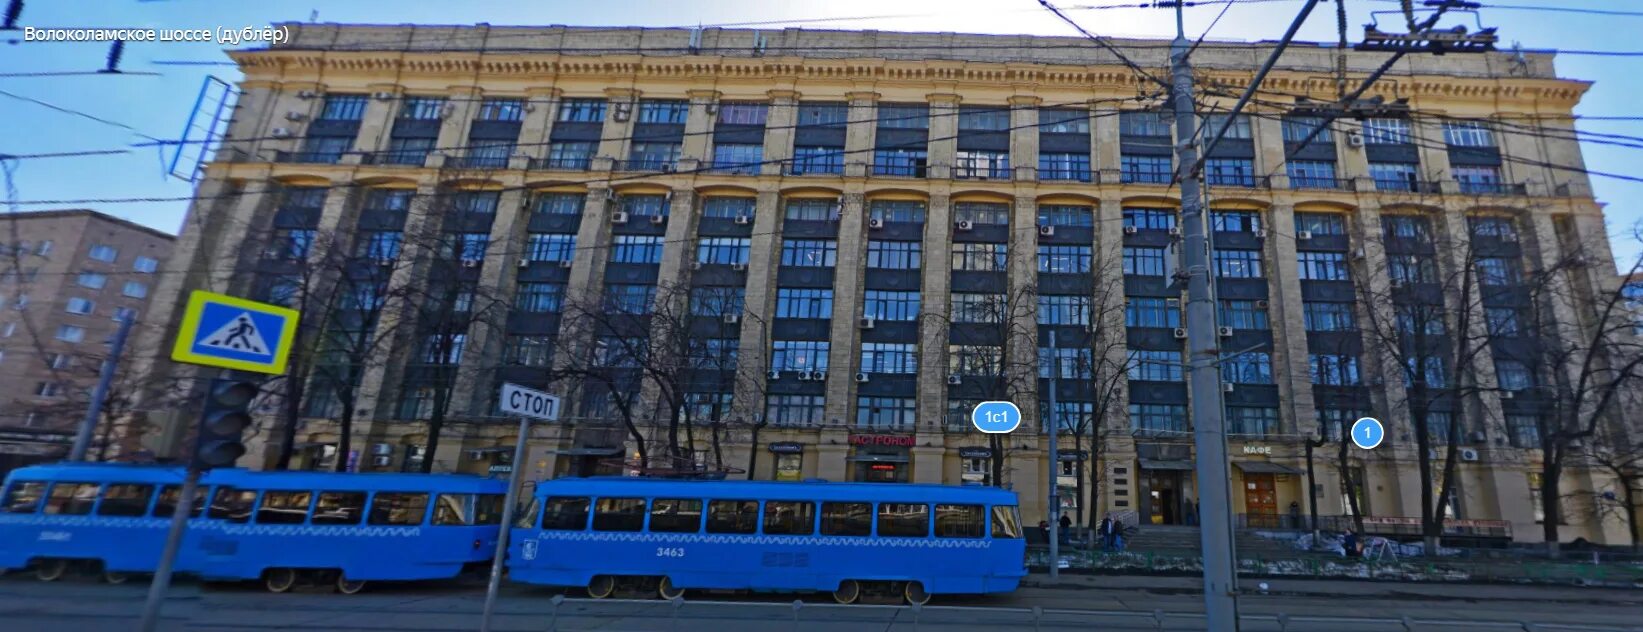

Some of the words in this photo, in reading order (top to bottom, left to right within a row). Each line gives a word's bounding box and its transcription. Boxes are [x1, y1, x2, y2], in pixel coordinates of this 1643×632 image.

[510, 390, 554, 417] СТОП
[849, 434, 915, 447] АСТРОНОМ
[656, 547, 685, 557] 3463
